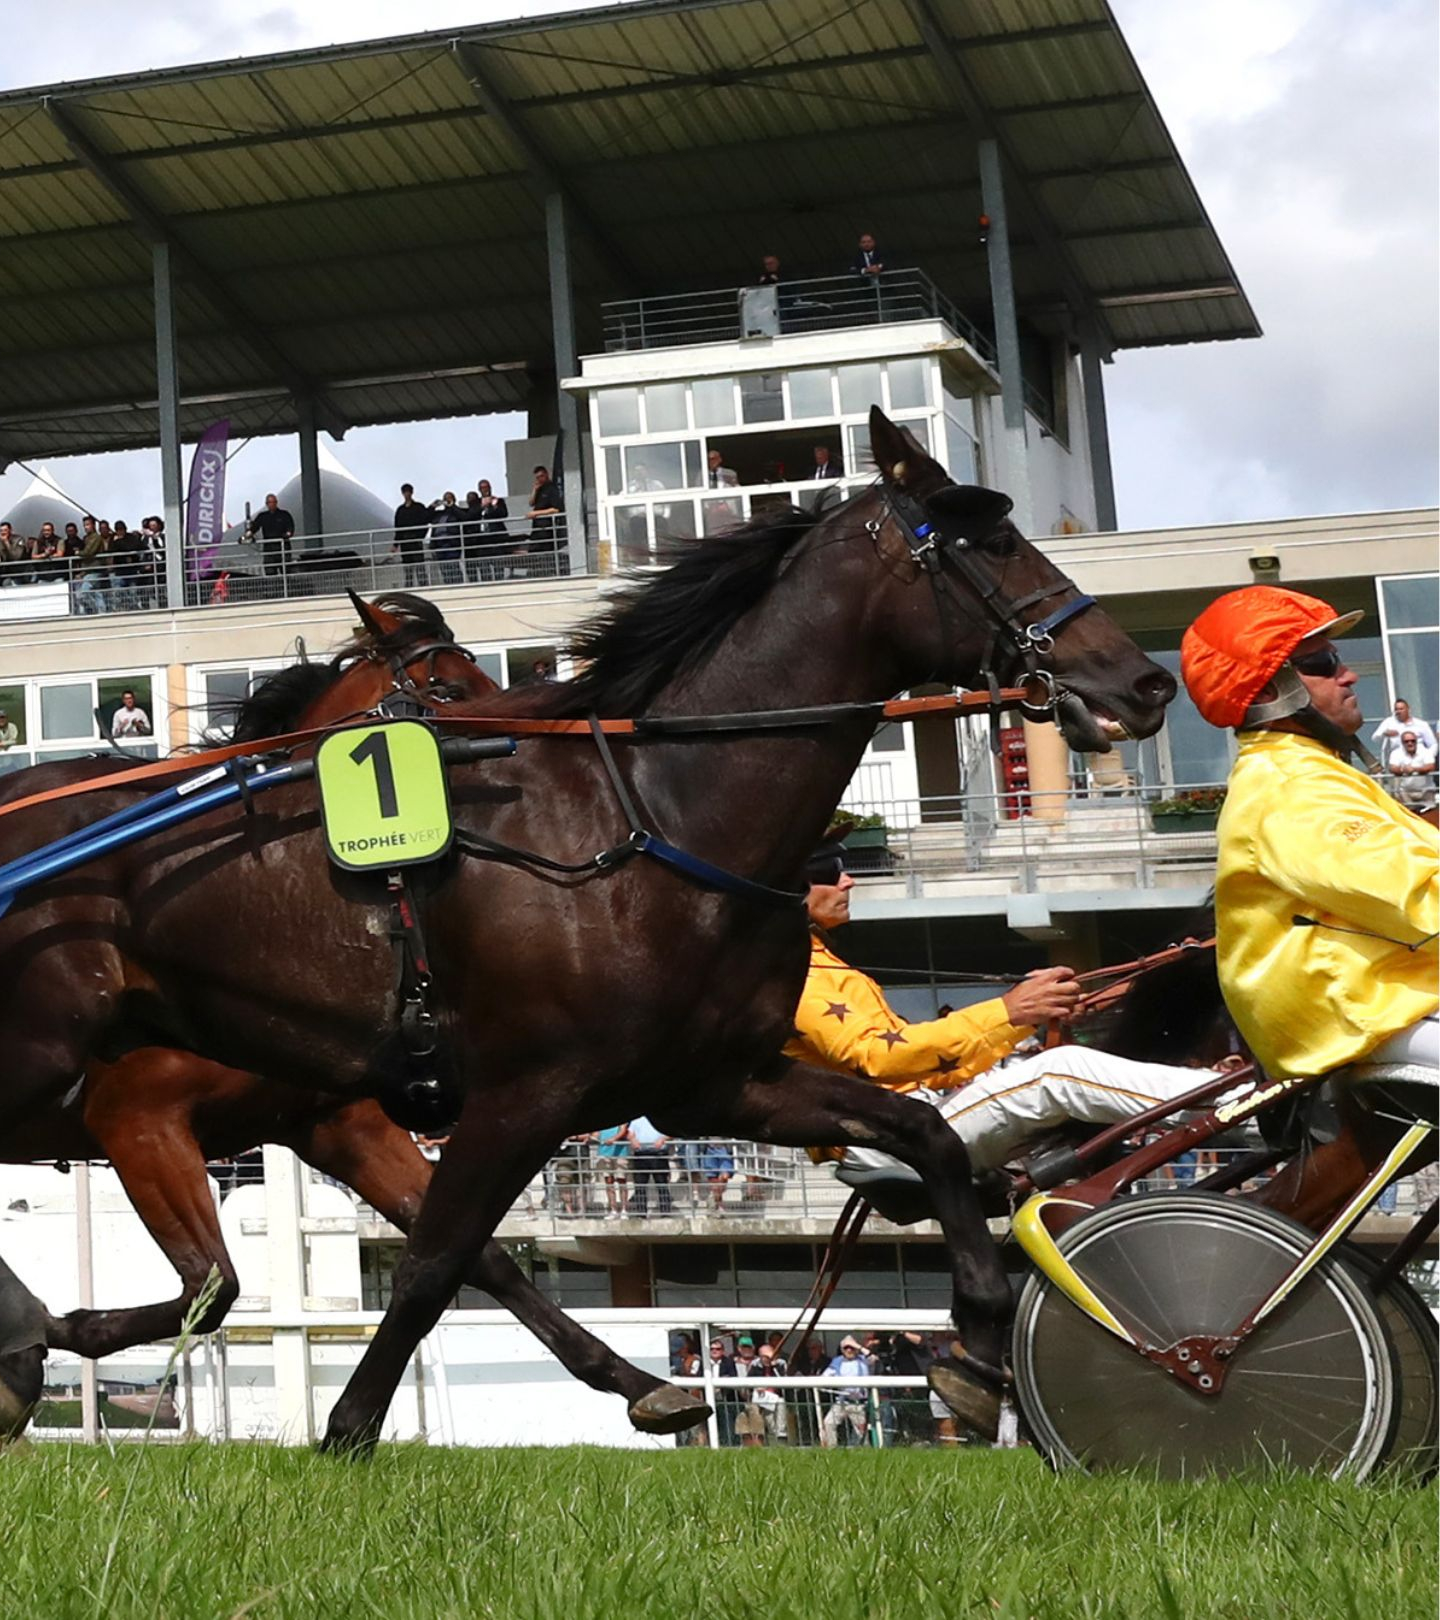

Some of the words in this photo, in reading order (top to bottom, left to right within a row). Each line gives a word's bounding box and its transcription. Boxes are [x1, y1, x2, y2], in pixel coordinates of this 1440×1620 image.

[198, 459, 216, 543] DIRICKX
[348, 731, 399, 819] 1
[338, 831, 406, 853] TROPHÉE
[410, 828, 441, 843] VERT
